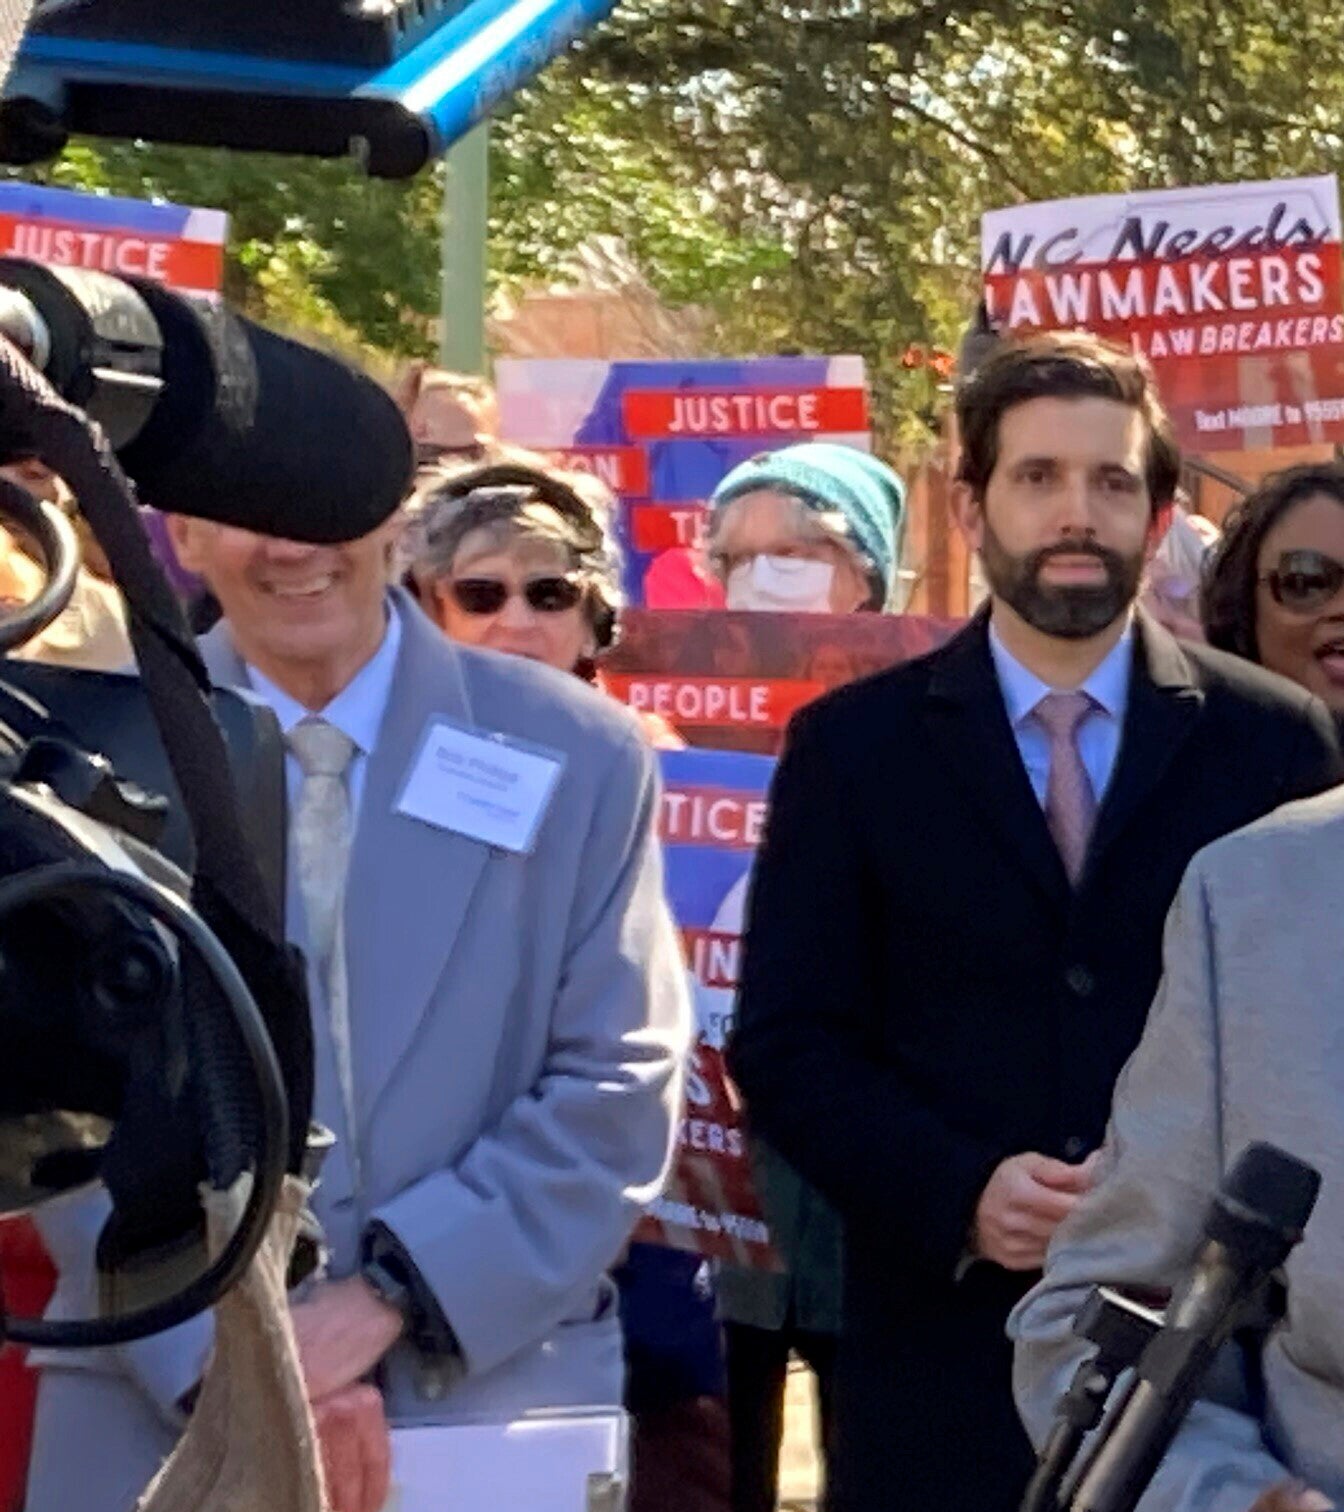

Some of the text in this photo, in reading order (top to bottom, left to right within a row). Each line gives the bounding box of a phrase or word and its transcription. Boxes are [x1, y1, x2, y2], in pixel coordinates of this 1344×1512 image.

[5, 222, 173, 281] JUSTICE
[988, 201, 1331, 276] NC Needs
[985, 252, 1325, 329] LAWMAKERS
[668, 394, 820, 432] JUSTICE
[628, 682, 770, 721] PEOPLE
[663, 792, 767, 844] TICE
